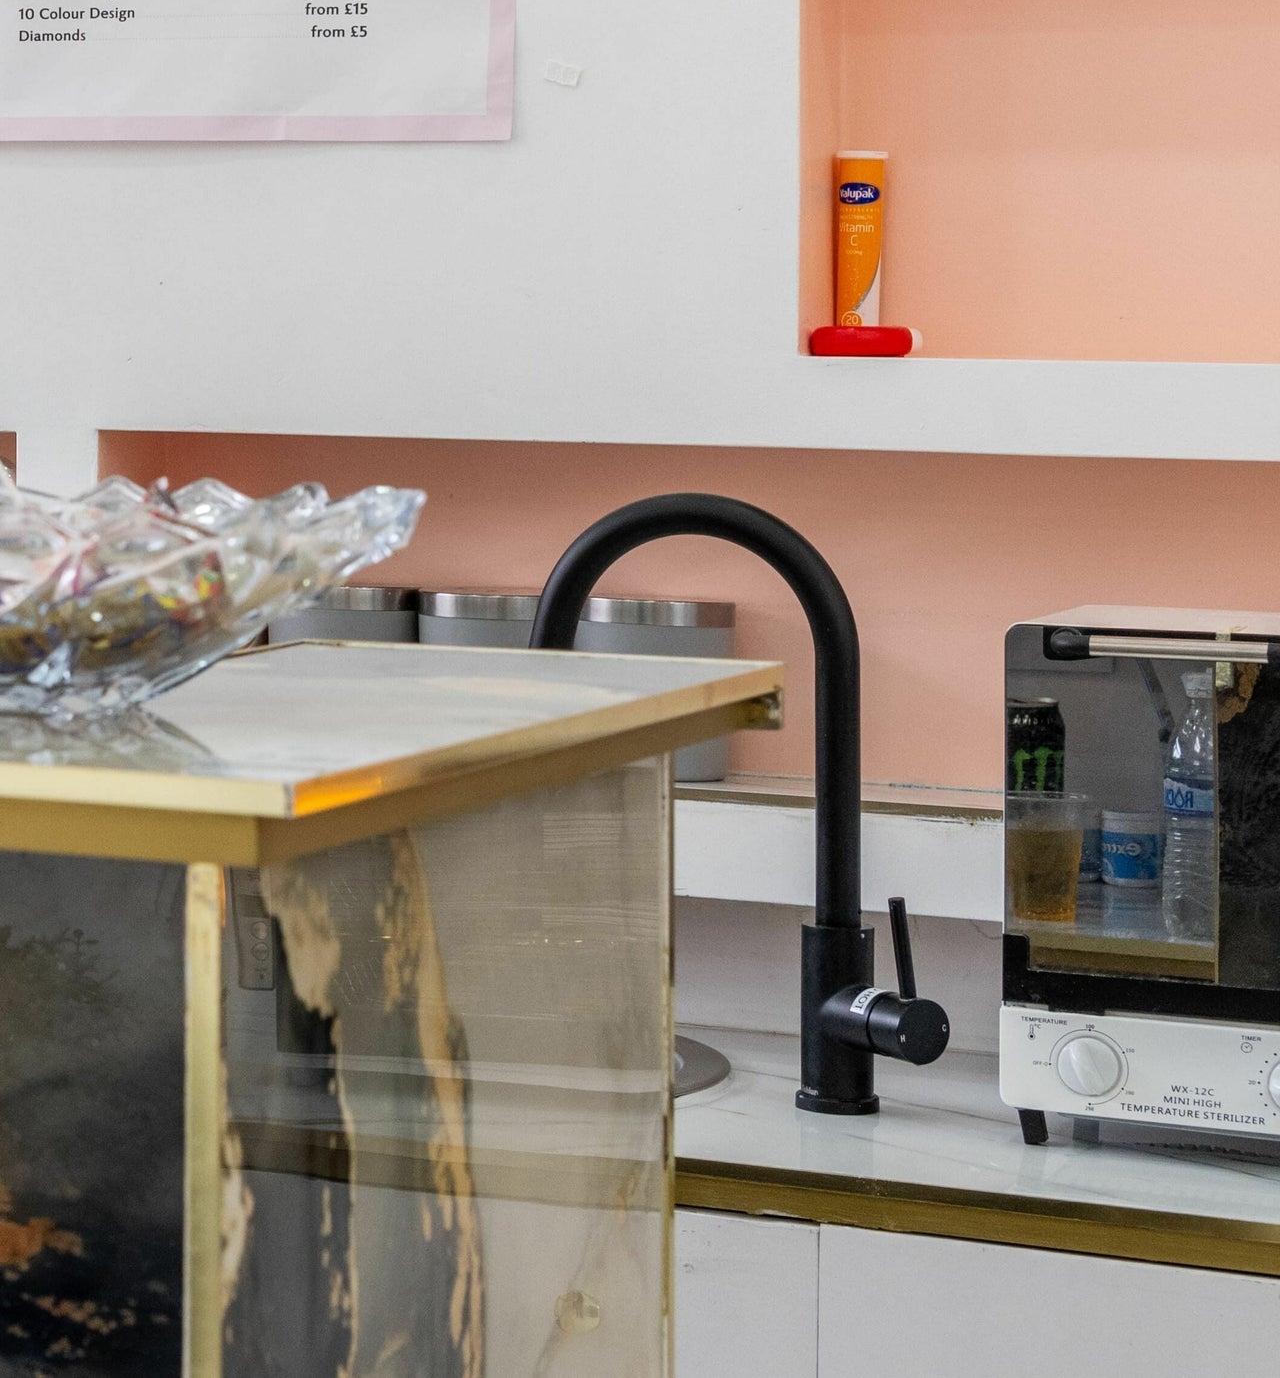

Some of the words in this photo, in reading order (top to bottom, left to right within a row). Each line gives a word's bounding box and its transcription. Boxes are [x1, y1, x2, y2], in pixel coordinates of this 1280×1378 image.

[18, 7, 35, 20] 10
[39, 6, 86, 20] Colour
[89, 7, 135, 23] Design
[304, 2, 339, 16] from
[344, 2, 368, 15] £15
[19, 28, 86, 42] Diamonds
[310, 24, 345, 38] from
[350, 25, 368, 38] £5
[840, 187, 874, 200] Valupak
[840, 221, 875, 233] Vitamin
[850, 234, 858, 246] C
[846, 314, 859, 325] 20
[1021, 1016, 1068, 1026] TEMPERATURE
[1241, 1034, 1262, 1042] TIMER
[1171, 1085, 1215, 1097] WX-12C
[1163, 1095, 1191, 1106] MINI
[1193, 1099, 1222, 1109] HIGH
[1120, 1102, 1200, 1119] TEMPERATURE
[1203, 1111, 1266, 1126] STERILIZER
